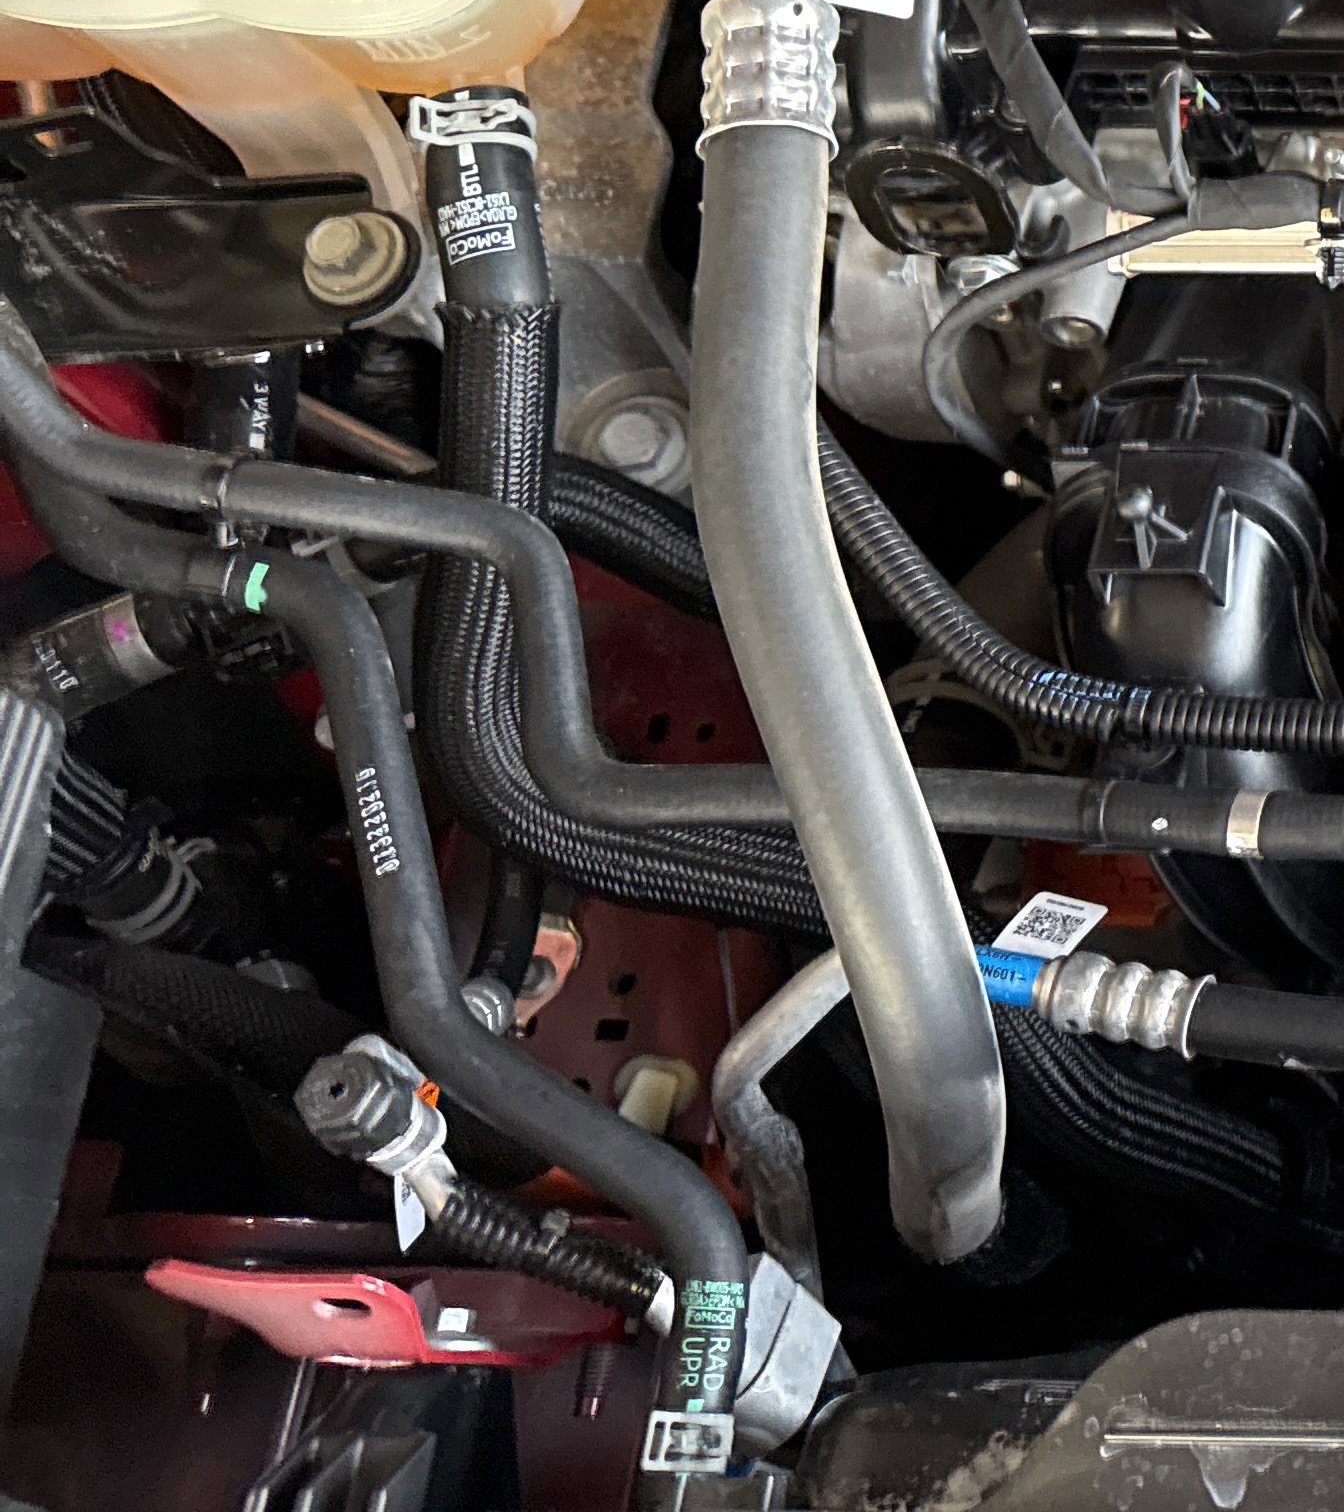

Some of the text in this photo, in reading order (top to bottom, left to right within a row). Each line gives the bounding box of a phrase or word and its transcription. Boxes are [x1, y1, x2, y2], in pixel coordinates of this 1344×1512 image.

[459, 163, 482, 198] BTL
[449, 229, 511, 256] FoMoCo
[680, 1337, 706, 1387] UPR
[703, 1337, 731, 1391] RAD
